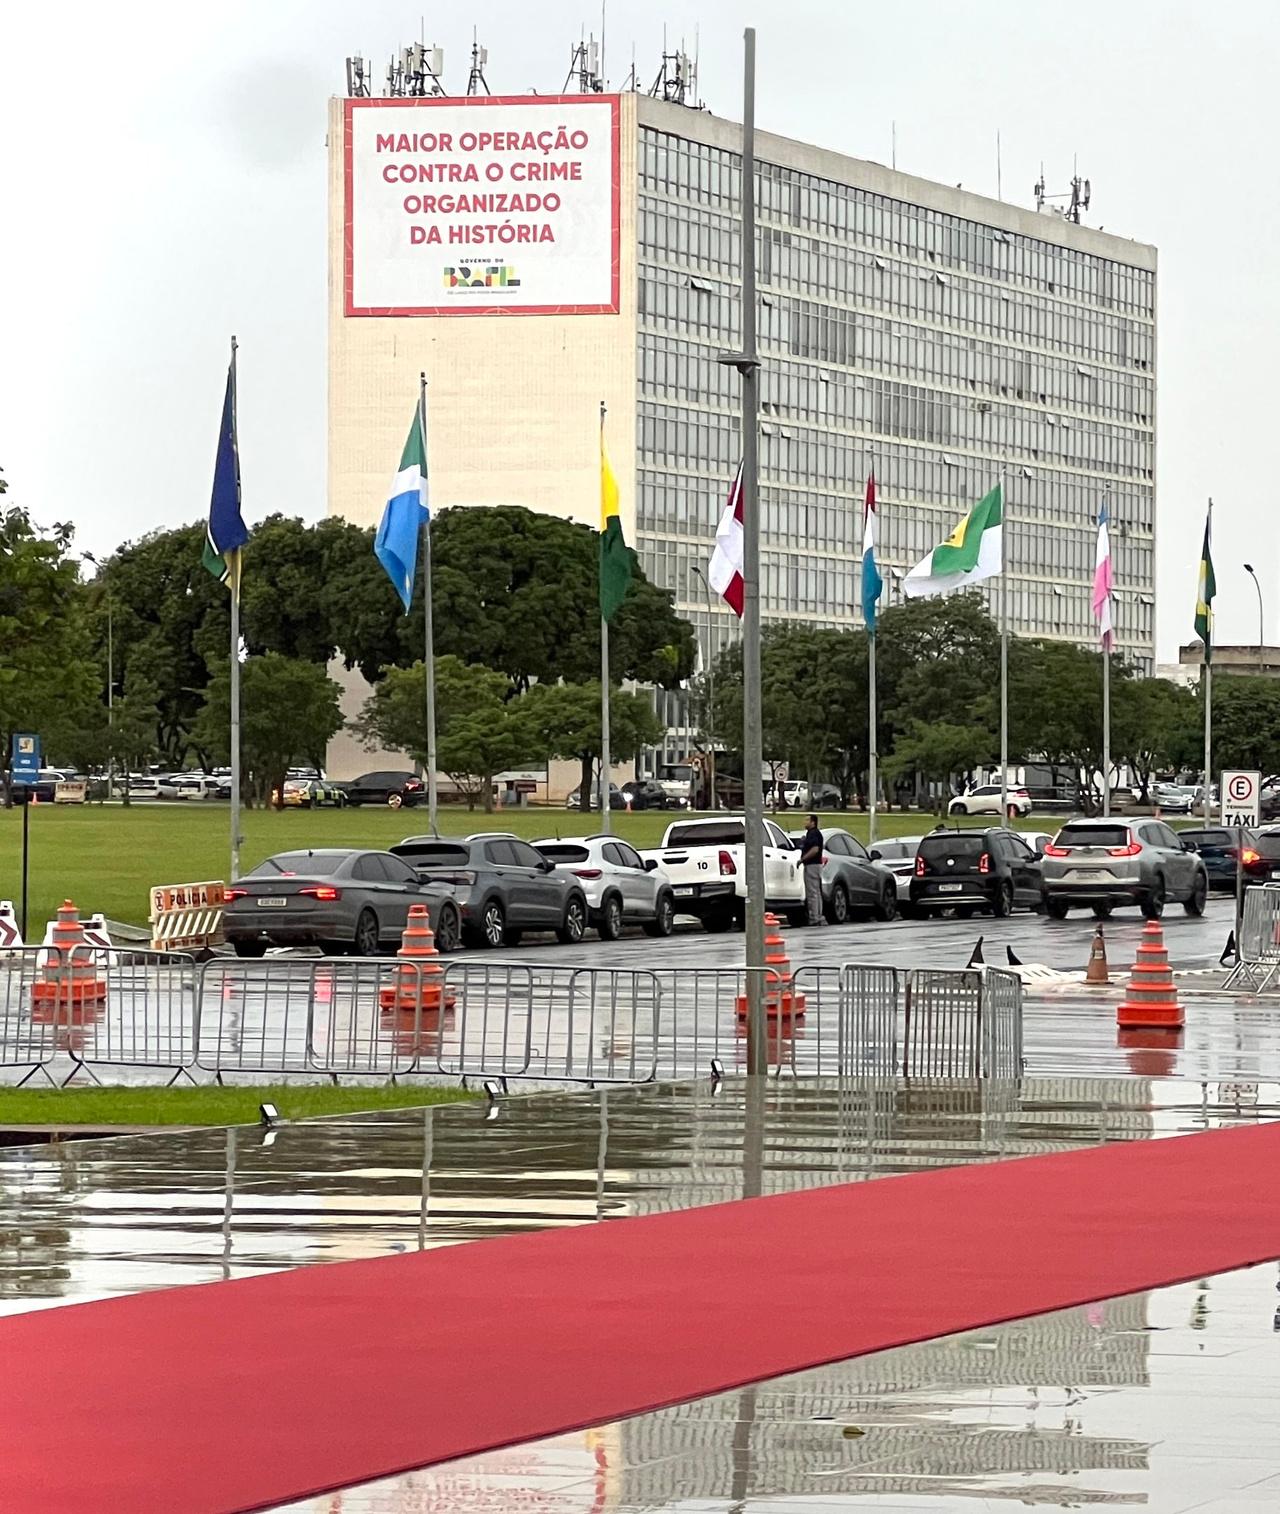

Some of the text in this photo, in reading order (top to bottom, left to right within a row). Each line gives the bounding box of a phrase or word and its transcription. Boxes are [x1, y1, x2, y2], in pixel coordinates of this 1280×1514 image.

[376, 126, 589, 155] MAIOR OPERAÇÃO
[382, 161, 582, 183] CONTRA O CRIME
[403, 192, 561, 214] ORGANIZADO
[410, 219, 555, 244] DA HISTÓRIA
[443, 266, 521, 287] BRASIL
[1236, 781, 1246, 795] E
[1224, 811, 1255, 827] TÁXI
[697, 861, 708, 870] 10
